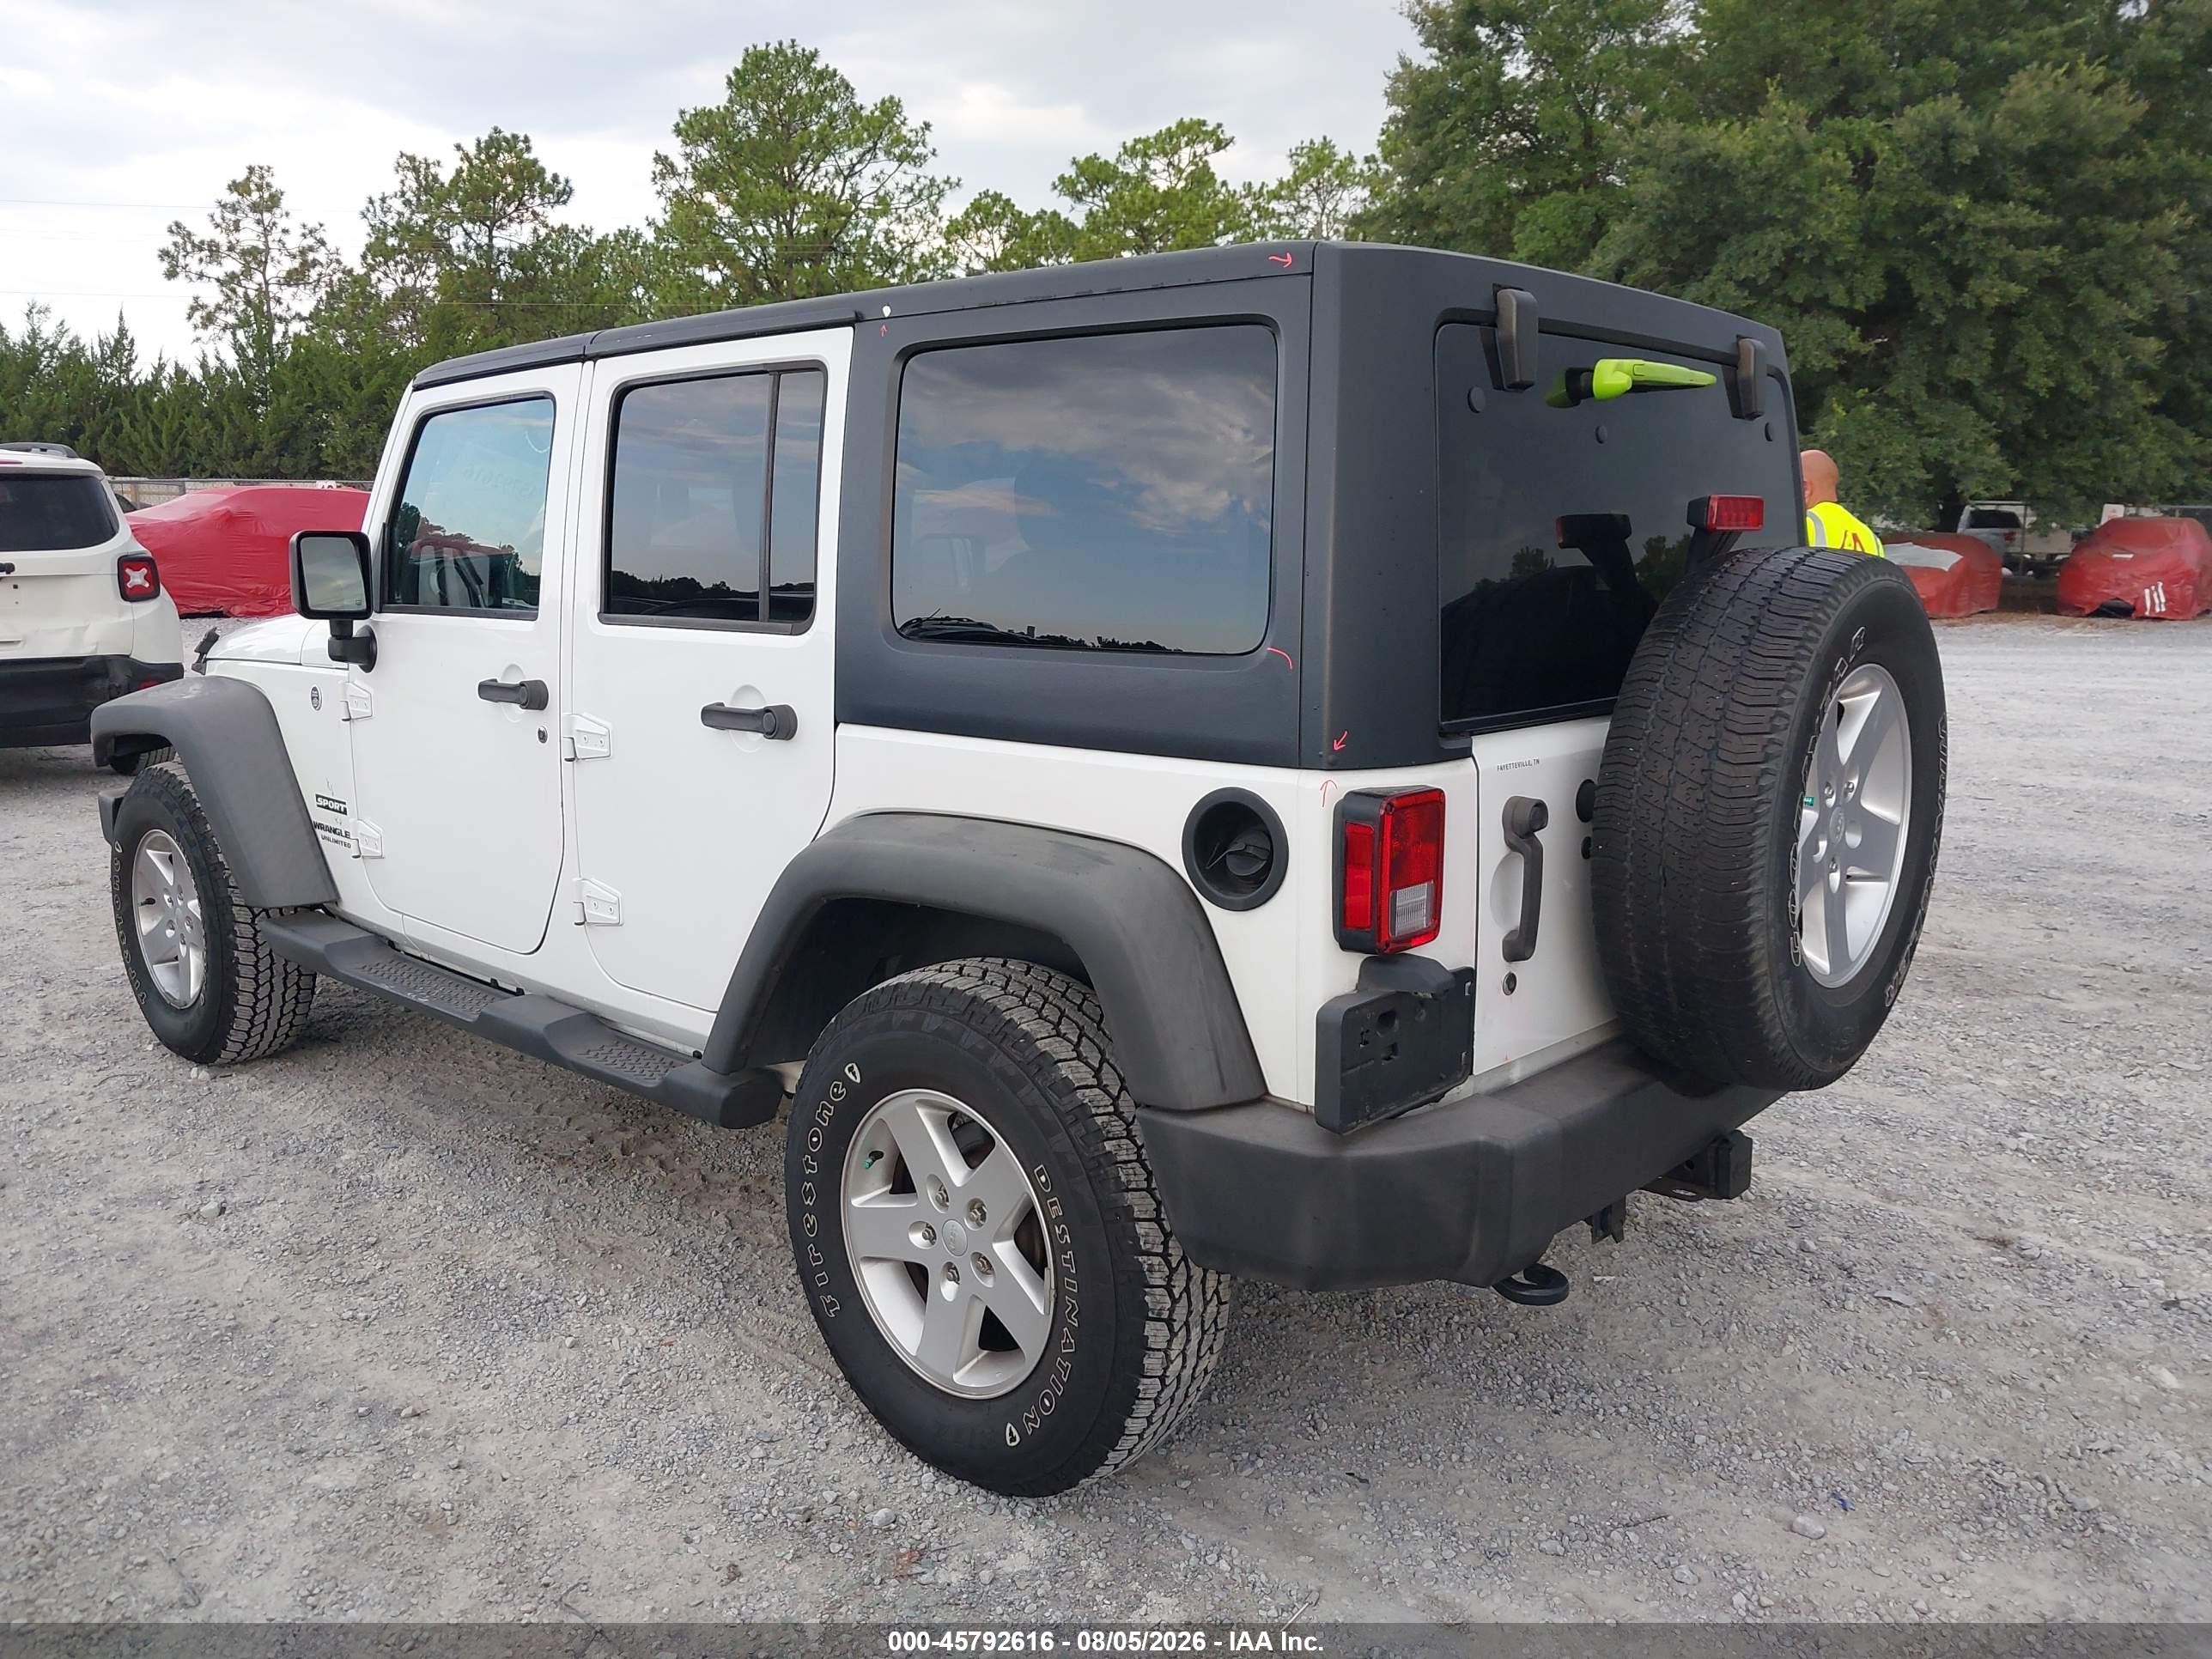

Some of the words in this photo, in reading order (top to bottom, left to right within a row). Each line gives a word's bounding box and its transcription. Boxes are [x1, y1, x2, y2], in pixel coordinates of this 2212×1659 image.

[1497, 760, 1532, 772] FAYETTEVILLE,
[316, 797, 348, 813] SPORT
[313, 820, 351, 840] WRANGLE
[320, 834, 351, 849] UNLIMITED
[800, 1079, 847, 1318] Firestone
[1024, 1164, 1079, 1436] DESTINATION
